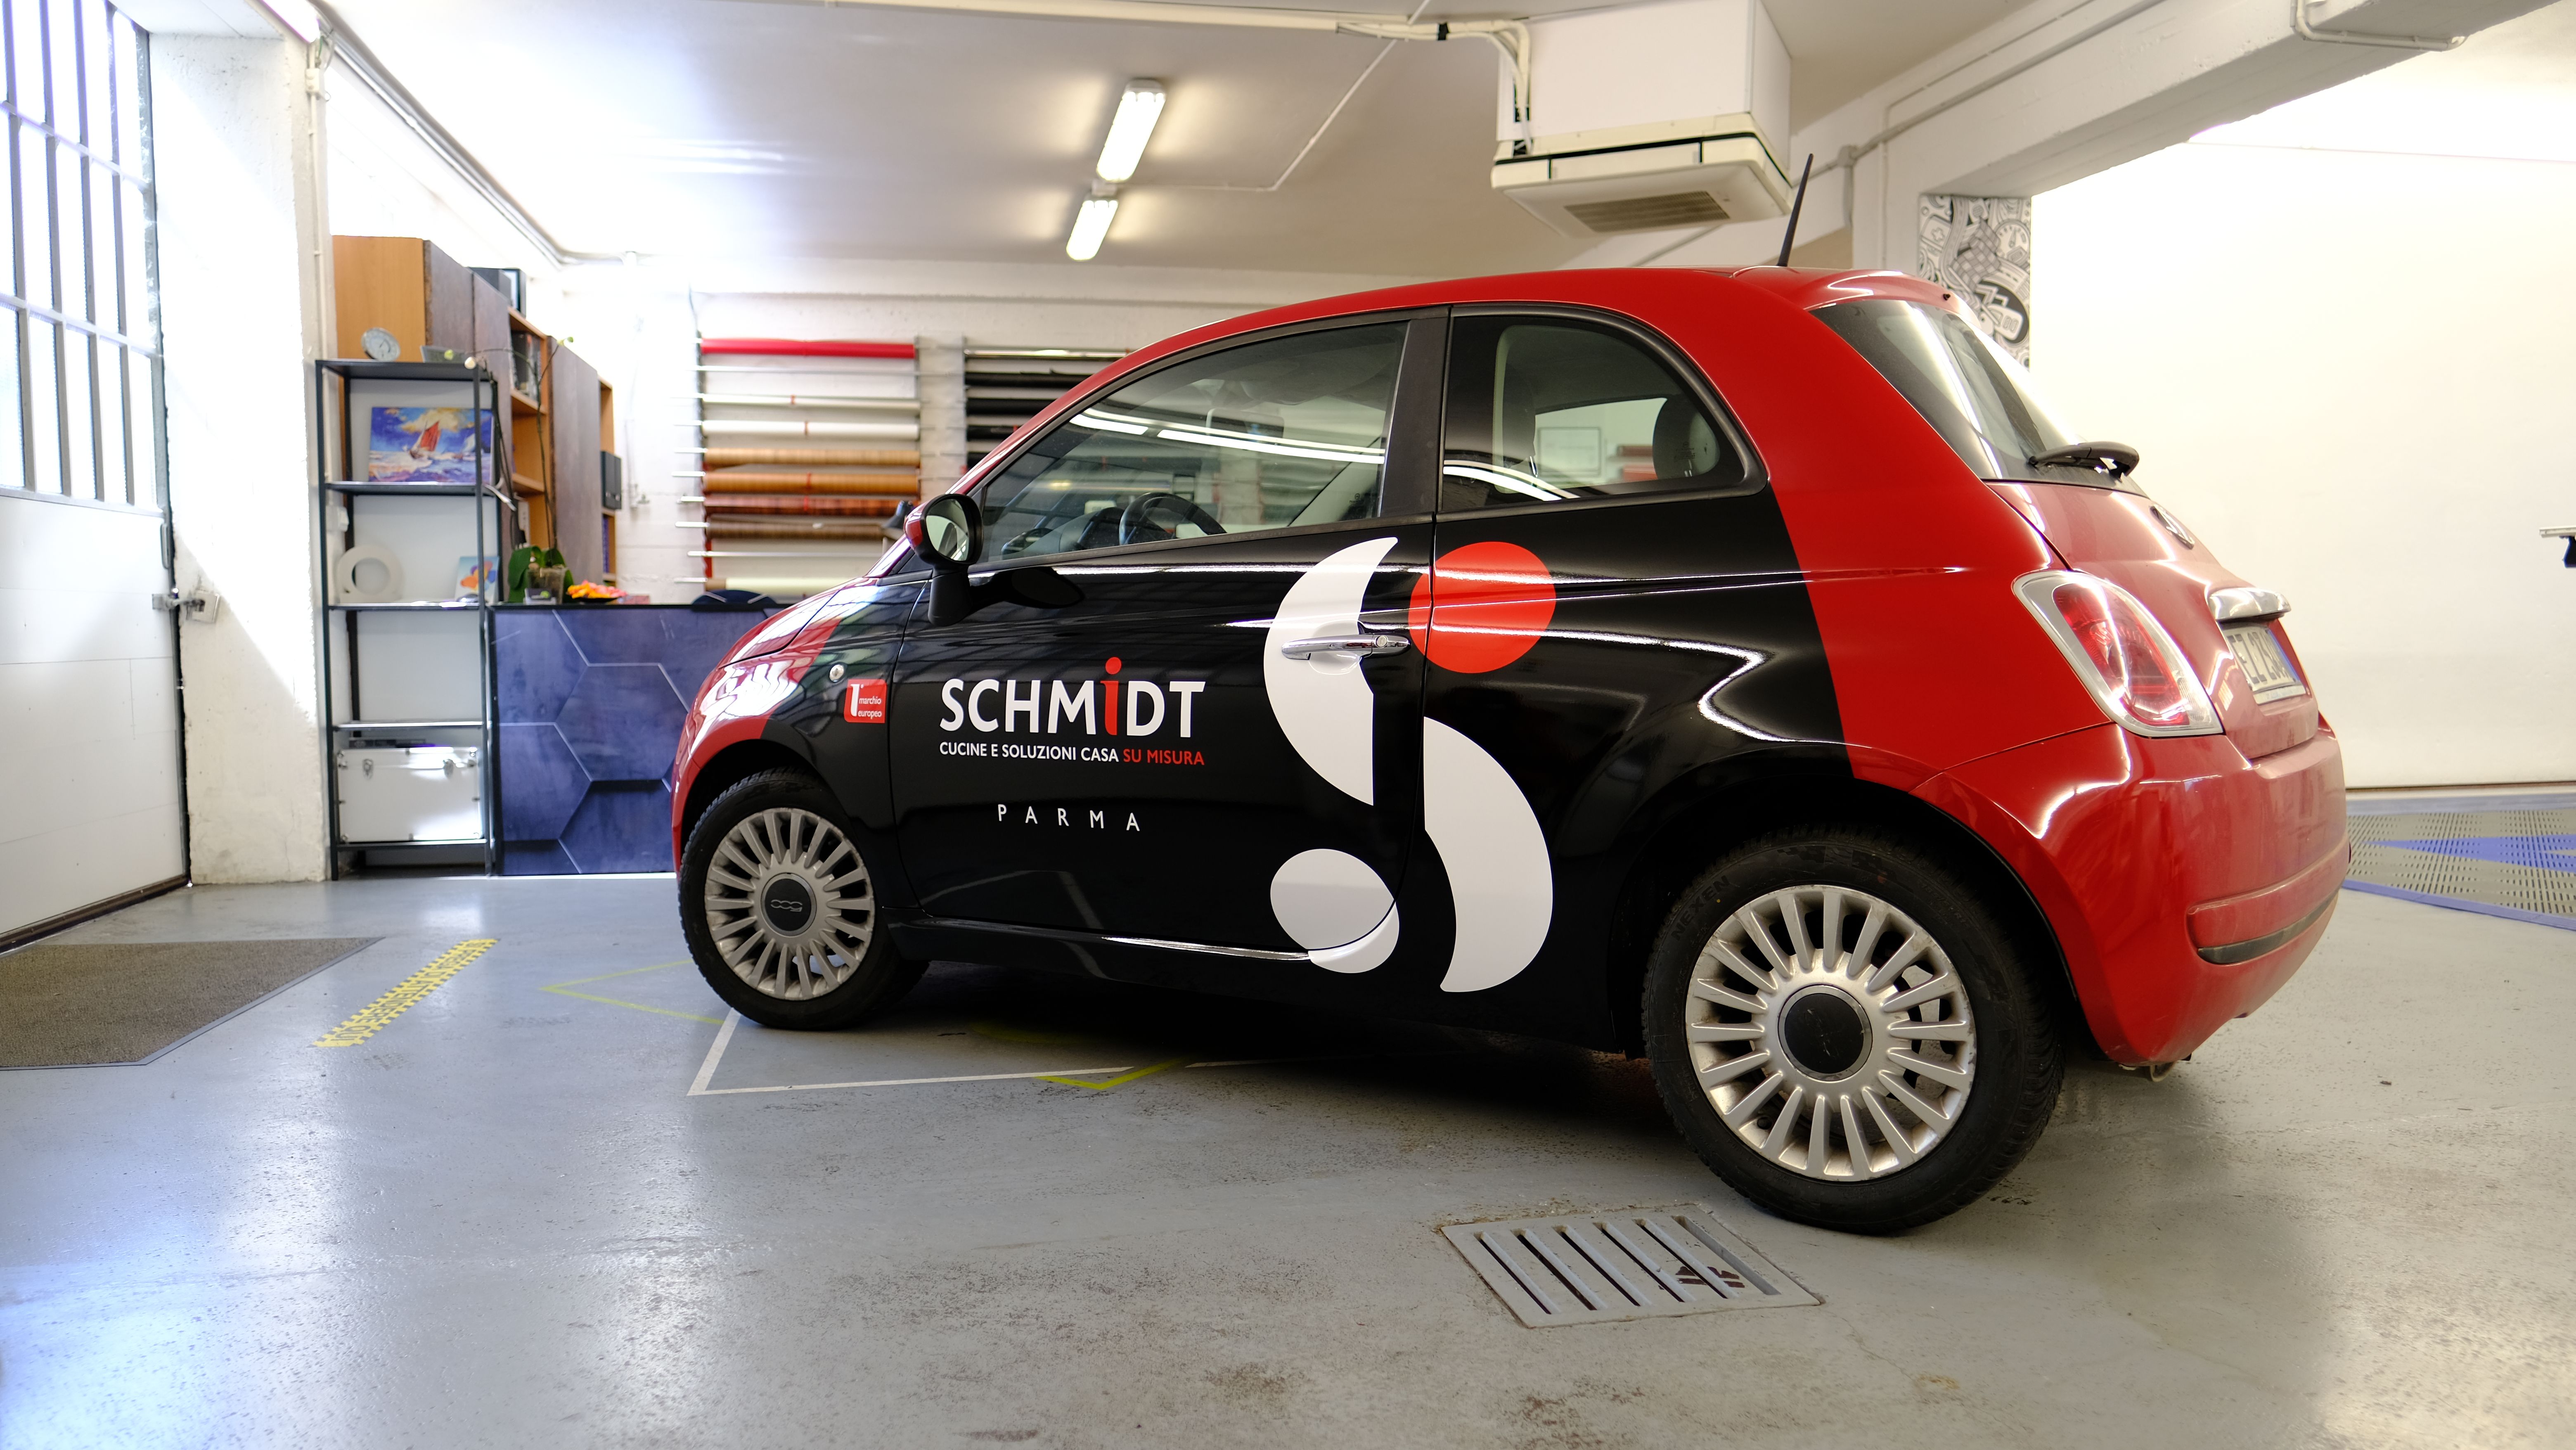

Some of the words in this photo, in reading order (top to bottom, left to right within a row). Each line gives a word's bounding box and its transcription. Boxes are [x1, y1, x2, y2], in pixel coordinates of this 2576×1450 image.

[859, 695, 881, 705] marchio
[858, 710, 882, 719] europeo
[940, 742, 987, 756] CUCINE
[991, 744, 998, 757] E
[1002, 744, 1076, 761] SOLUZIONI
[1081, 747, 1119, 762] CASA
[1123, 749, 1141, 763] SU
[1147, 749, 1205, 765] MISURA
[998, 804, 1140, 832] PARMA
[1670, 874, 1730, 941] NEXEN
[355, 980, 434, 1023] ATTENDERE
[329, 1025, 372, 1041] QUI
